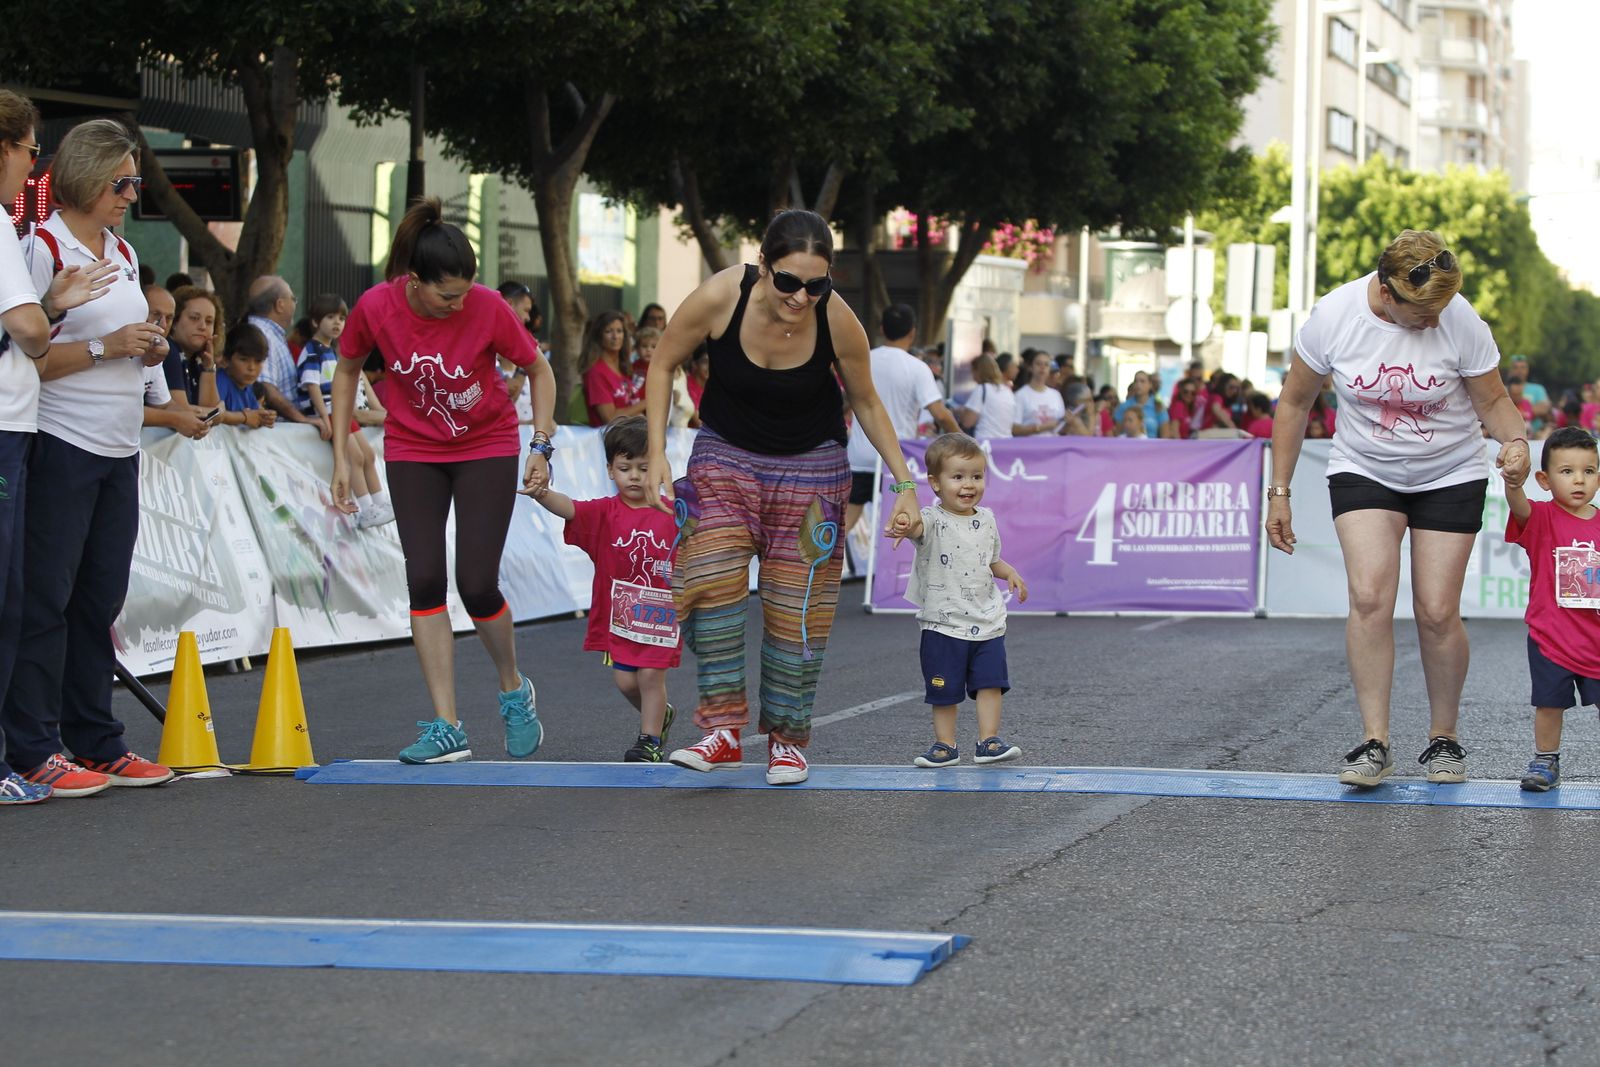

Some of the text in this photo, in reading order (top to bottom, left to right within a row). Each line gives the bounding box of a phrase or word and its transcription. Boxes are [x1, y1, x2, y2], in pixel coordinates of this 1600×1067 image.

[139, 449, 210, 531] RERA
[1075, 481, 1251, 566] 4 CARRERA
[1118, 544, 1131, 552] POR
[1132, 544, 1145, 552] LAS
[1120, 511, 1250, 538] SOLIDARIA
